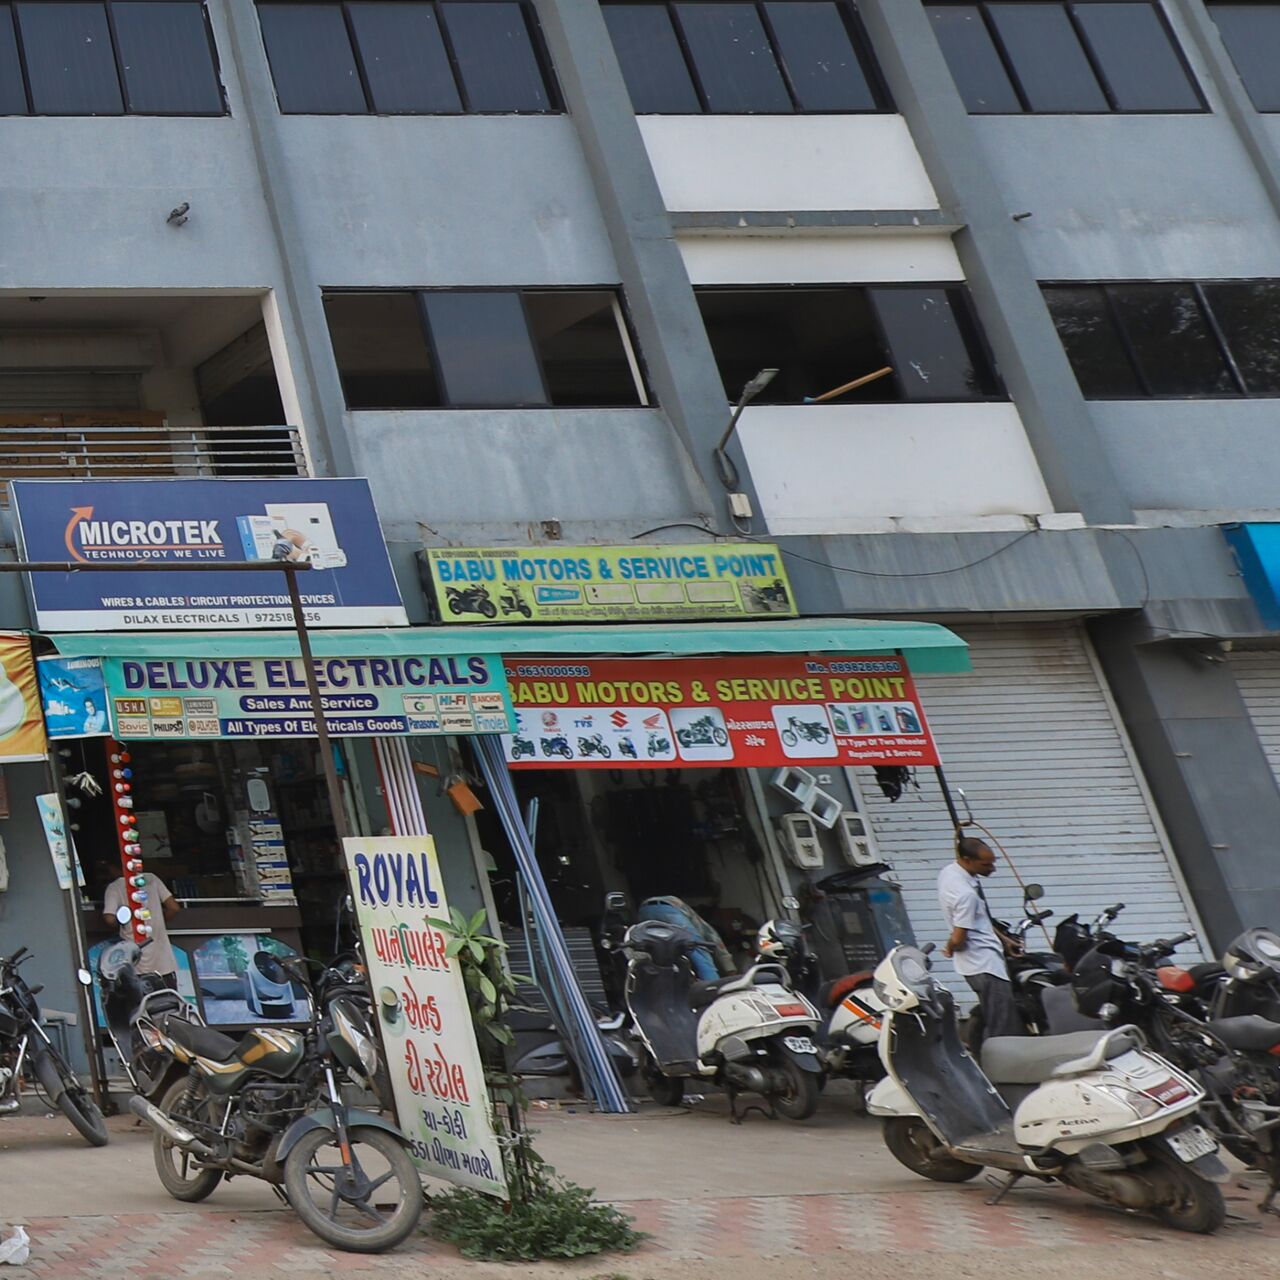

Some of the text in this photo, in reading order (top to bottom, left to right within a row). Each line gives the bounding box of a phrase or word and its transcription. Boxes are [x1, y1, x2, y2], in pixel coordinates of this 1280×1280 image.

[79, 520, 222, 545] MICROTEK
[84, 550, 226, 558] TECHNOLOGY WE LIVE
[436, 554, 777, 581] BABU MOTORS & SERVICE POINT
[101, 594, 335, 607] WIRES & CABLES CIRCUIT PROTECTION EVICES
[124, 616, 158, 624] DILAX
[162, 614, 239, 624] ELECTRICALS
[122, 656, 489, 690] DELUXE ELECTRICALS
[509, 677, 905, 704] BABU MOTORS & SERVICE POINT
[116, 701, 146, 712] USHA
[246, 697, 287, 710] Sales
[321, 697, 373, 709] Service
[440, 695, 466, 705] HI-FI
[154, 723, 178, 732] PHILIPS
[227, 721, 243, 733] All
[245, 721, 282, 735] Types
[284, 721, 301, 732] Of
[302, 720, 364, 732] Eletricals
[367, 719, 404, 732] Goods
[574, 720, 593, 728] TVS
[354, 852, 438, 907] ROYAL
[402, 975, 442, 1033] એન્ડ
